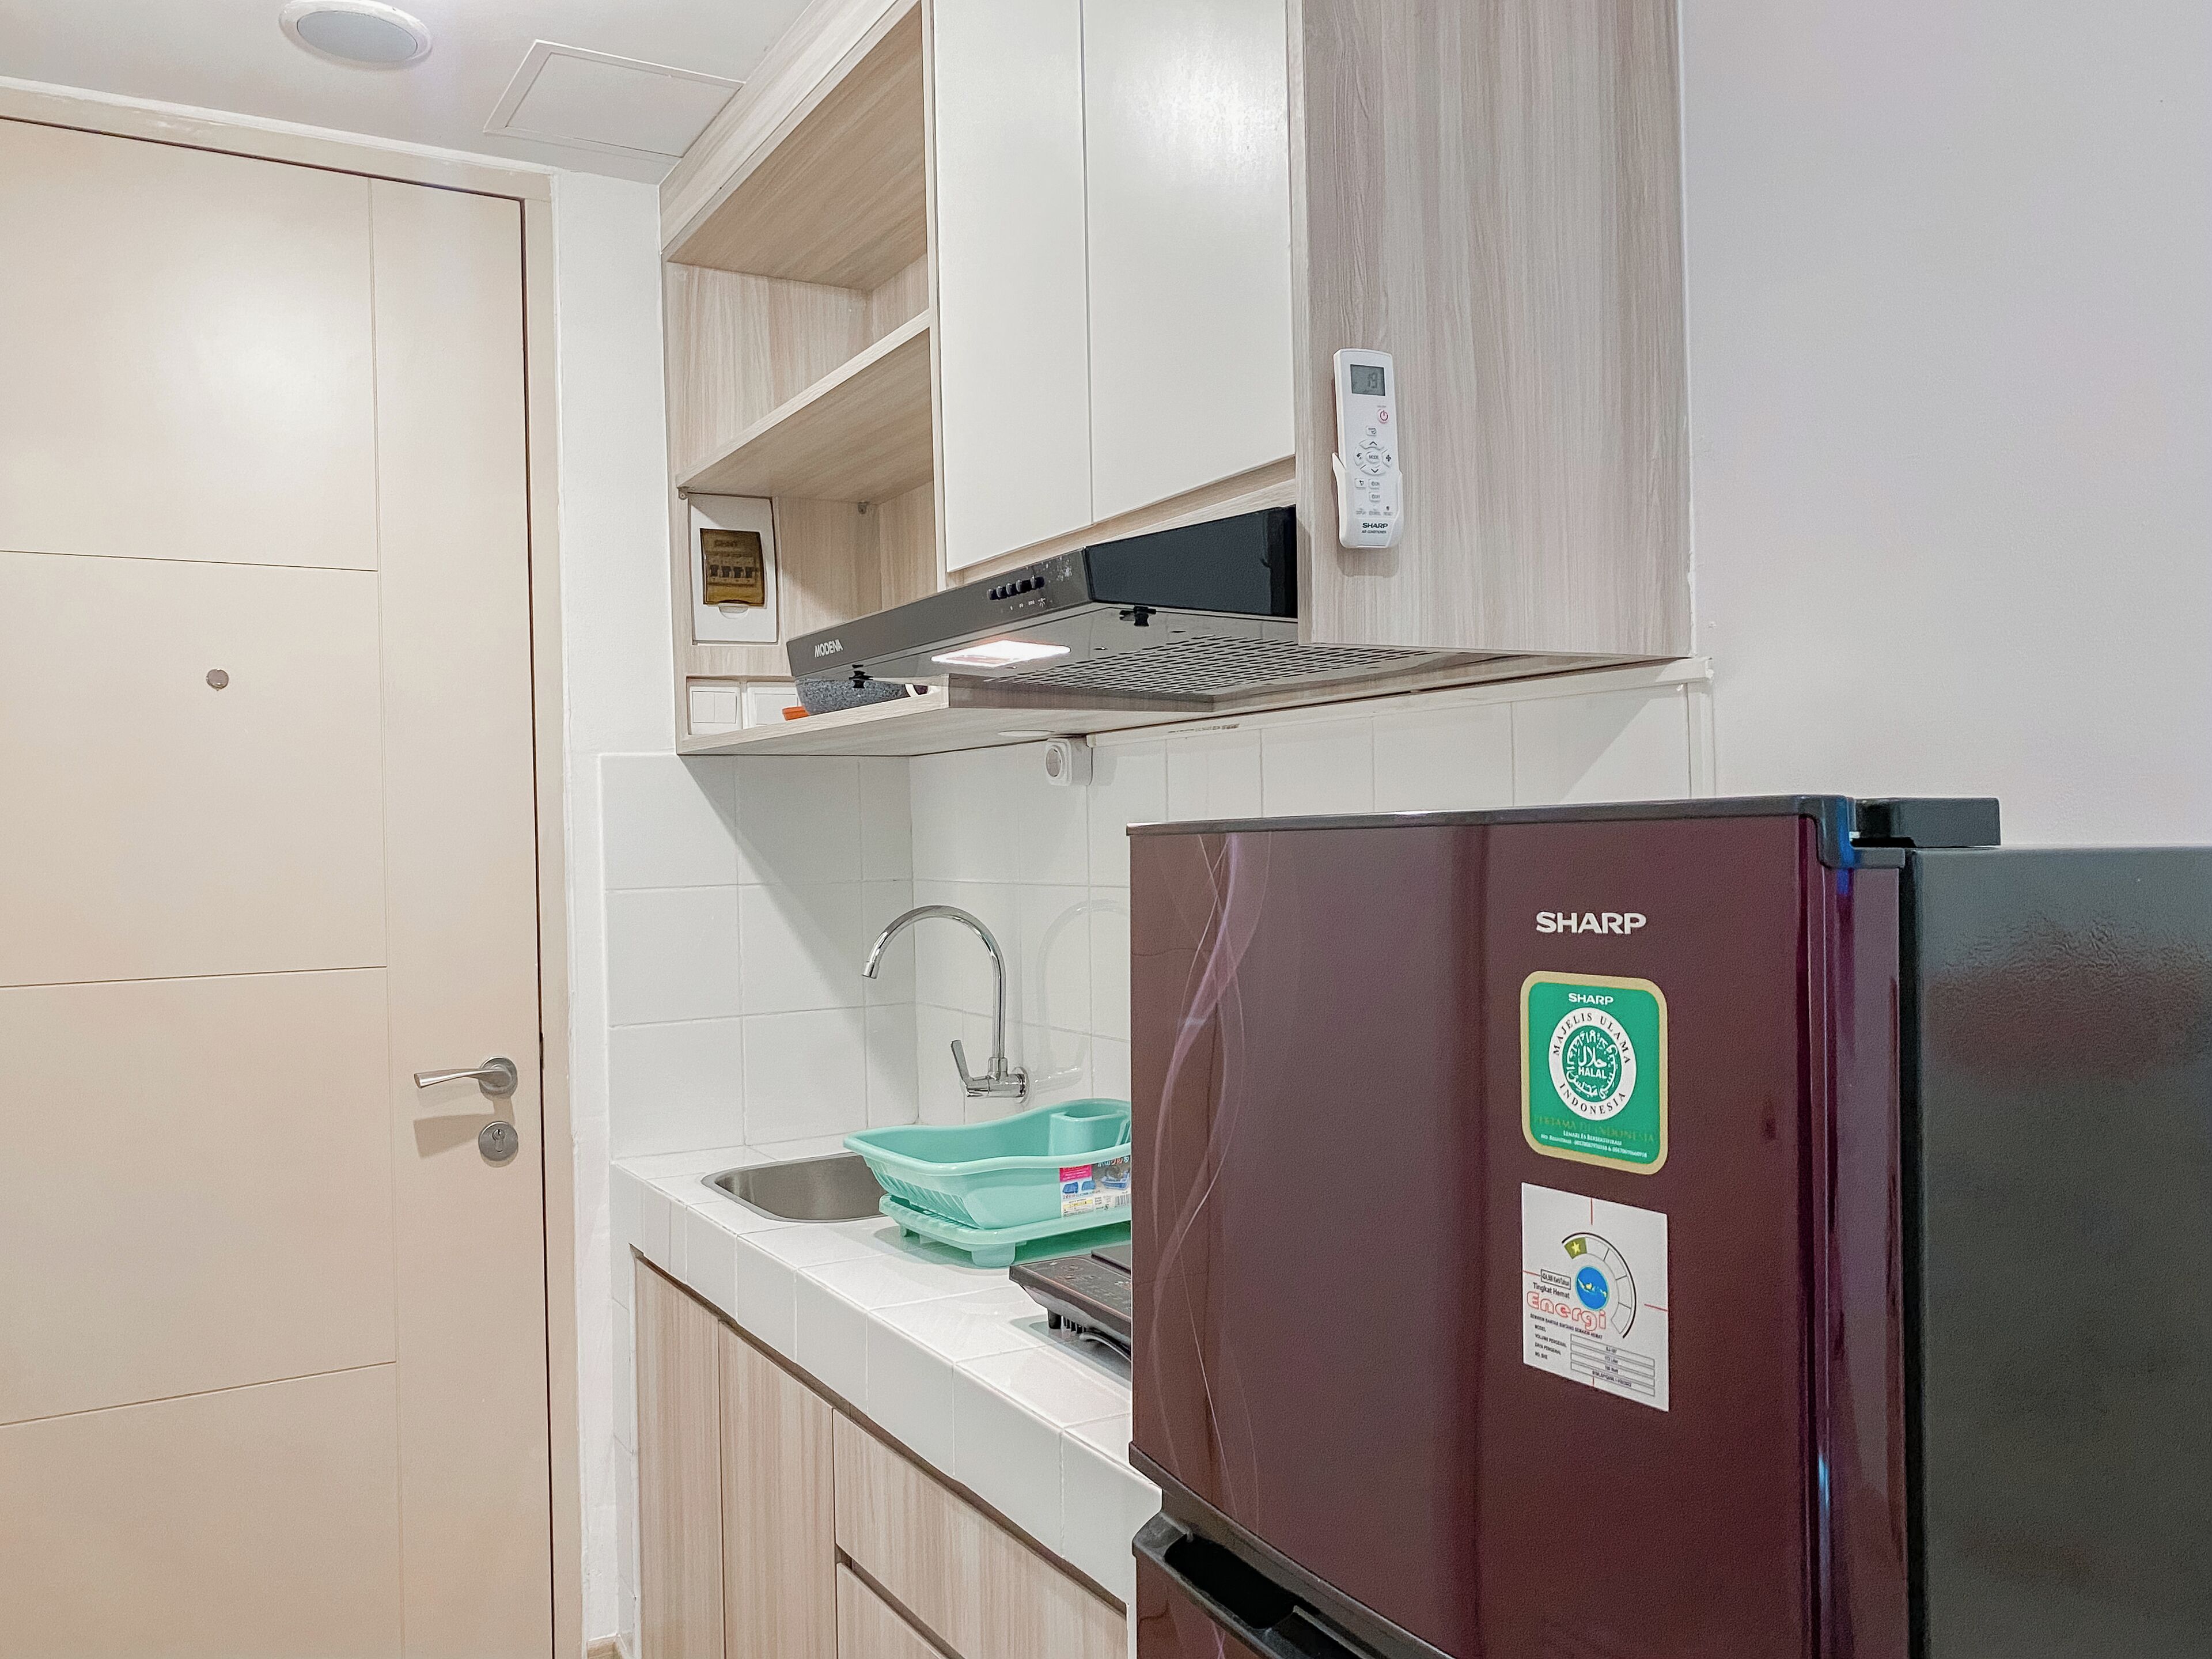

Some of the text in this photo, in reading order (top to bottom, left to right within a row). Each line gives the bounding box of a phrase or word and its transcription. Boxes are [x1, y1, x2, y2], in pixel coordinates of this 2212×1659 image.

[815, 639, 843, 658] MODENA
[1535, 911, 1647, 935] SHARP
[1568, 993, 1614, 1006] SHARP
[1552, 1012, 1631, 1065] MAJELIS ULAMA
[1578, 1066, 1607, 1079] HALAL
[1559, 1082, 1626, 1115] INDONESIA
[1533, 1282, 1570, 1299] Tingkat Hemat
[1527, 1291, 1607, 1331] Energi
